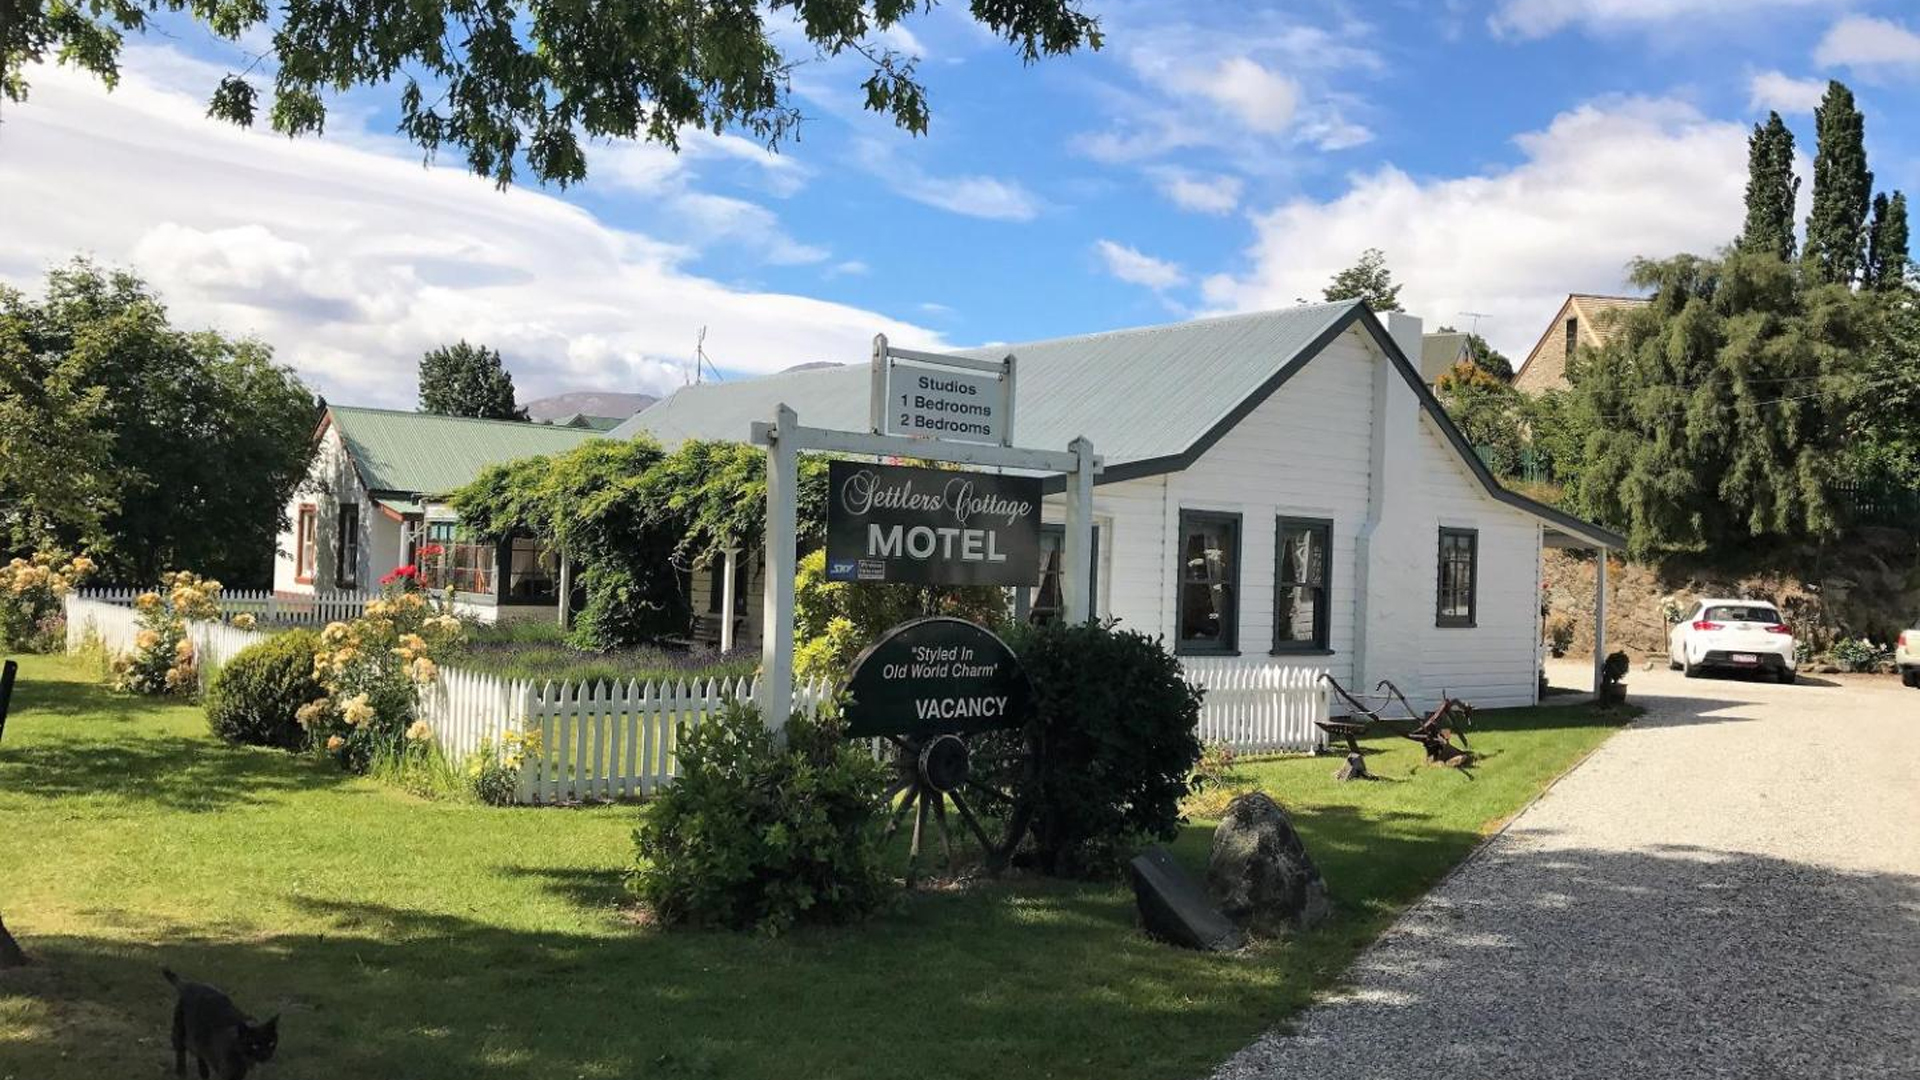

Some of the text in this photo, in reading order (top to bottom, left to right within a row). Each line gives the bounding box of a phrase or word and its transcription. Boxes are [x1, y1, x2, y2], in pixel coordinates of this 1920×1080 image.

[918, 376, 977, 396] Studios
[901, 394, 992, 417] 1 Bedrooms
[900, 413, 991, 436] 2 Bedrooms
[841, 469, 1032, 526] Settlers Cottage
[868, 524, 1007, 562] MOTEL
[961, 647, 973, 661] In
[883, 663, 907, 679] Old
[911, 663, 947, 678] World
[915, 697, 1008, 720] VACANCY
